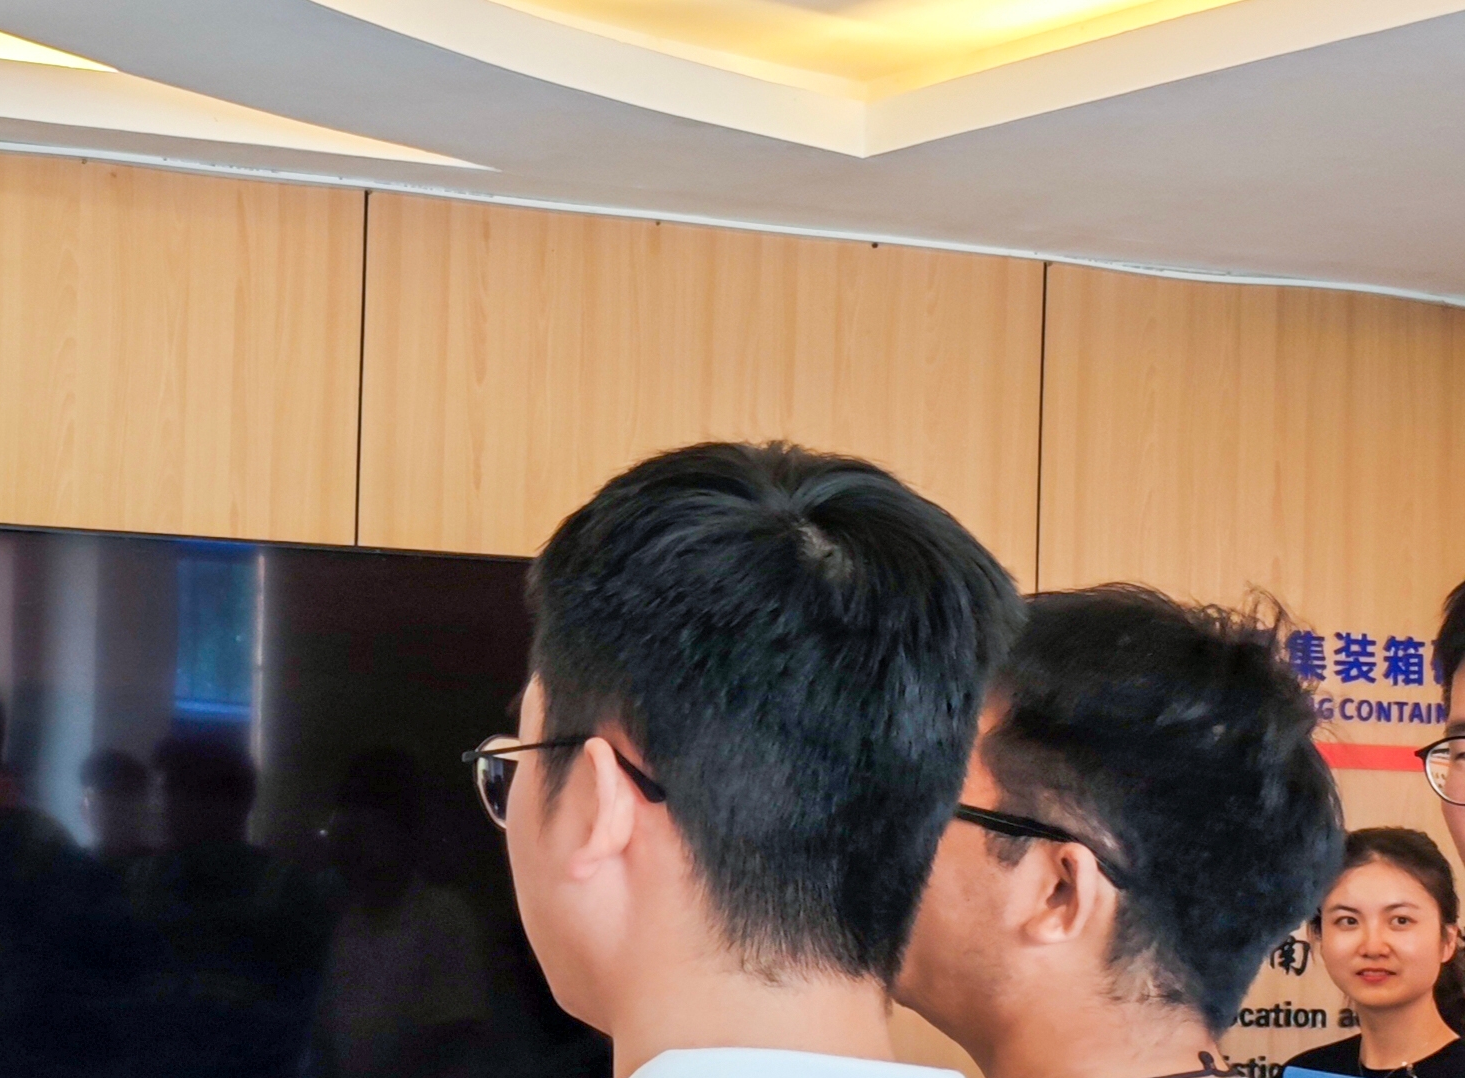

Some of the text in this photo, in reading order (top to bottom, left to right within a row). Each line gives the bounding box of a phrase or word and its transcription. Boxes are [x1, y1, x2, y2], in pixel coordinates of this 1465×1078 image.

[1286, 629, 1446, 687] 集装箱
[1233, 1001, 1328, 1028] cation
